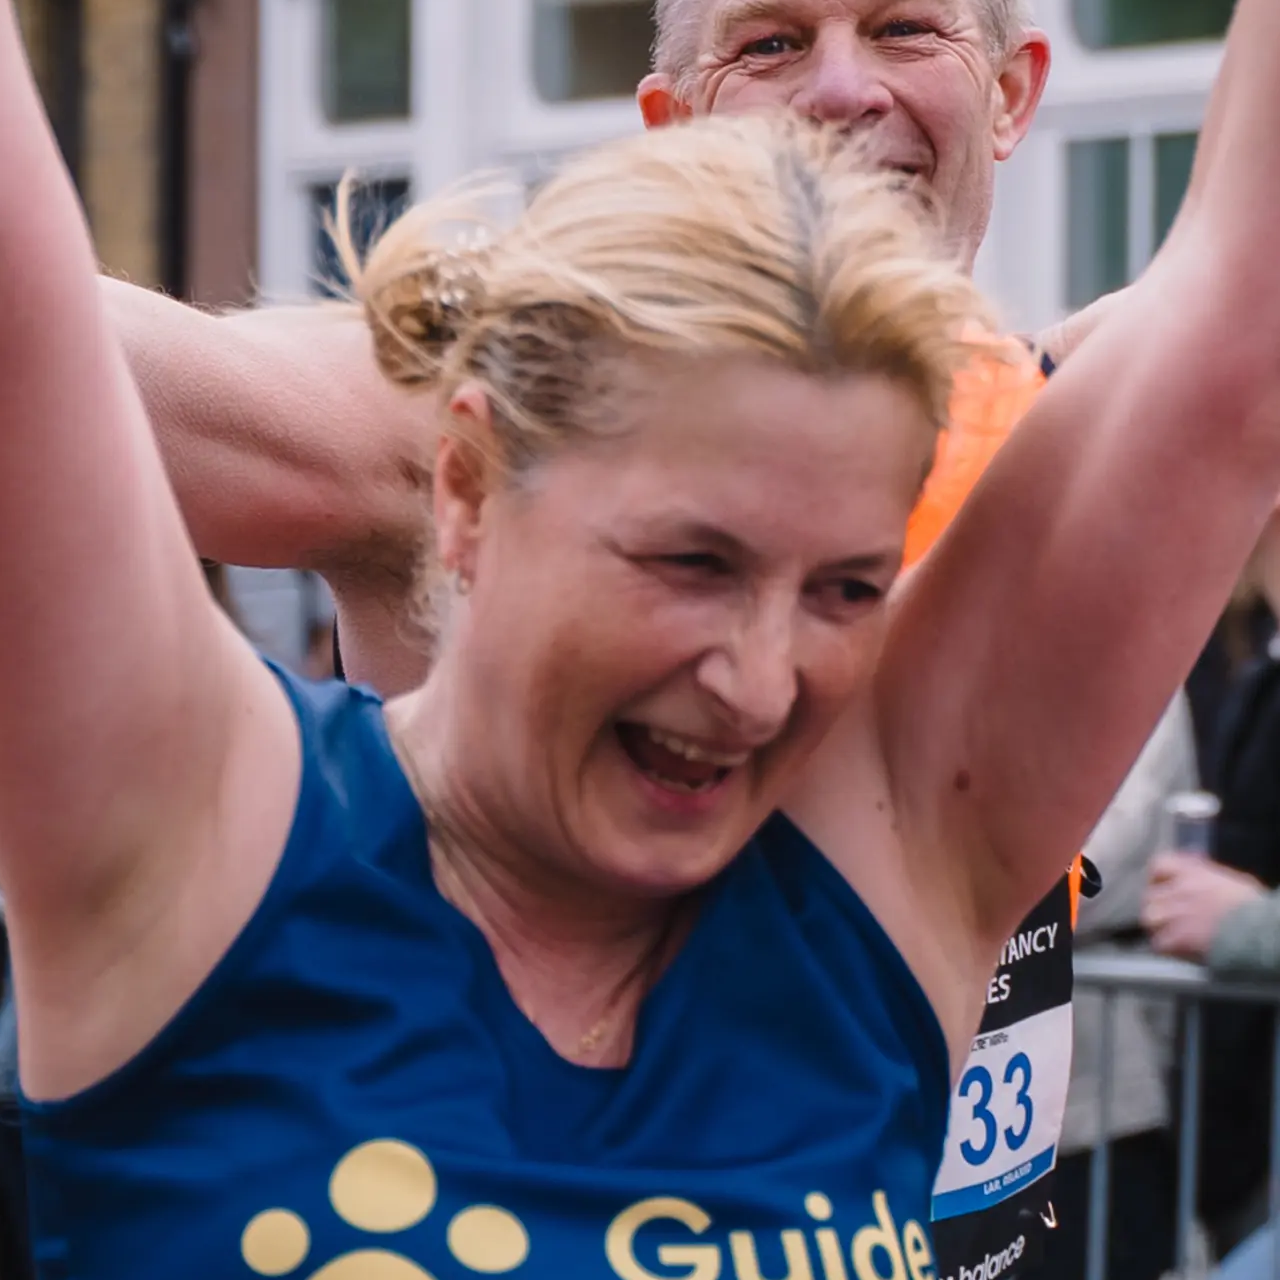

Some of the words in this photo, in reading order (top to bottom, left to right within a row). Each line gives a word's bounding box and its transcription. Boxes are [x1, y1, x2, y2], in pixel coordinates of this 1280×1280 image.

[999, 922, 1058, 966] TANCY
[986, 974, 1011, 1004] ES
[958, 1052, 1033, 1167] 33
